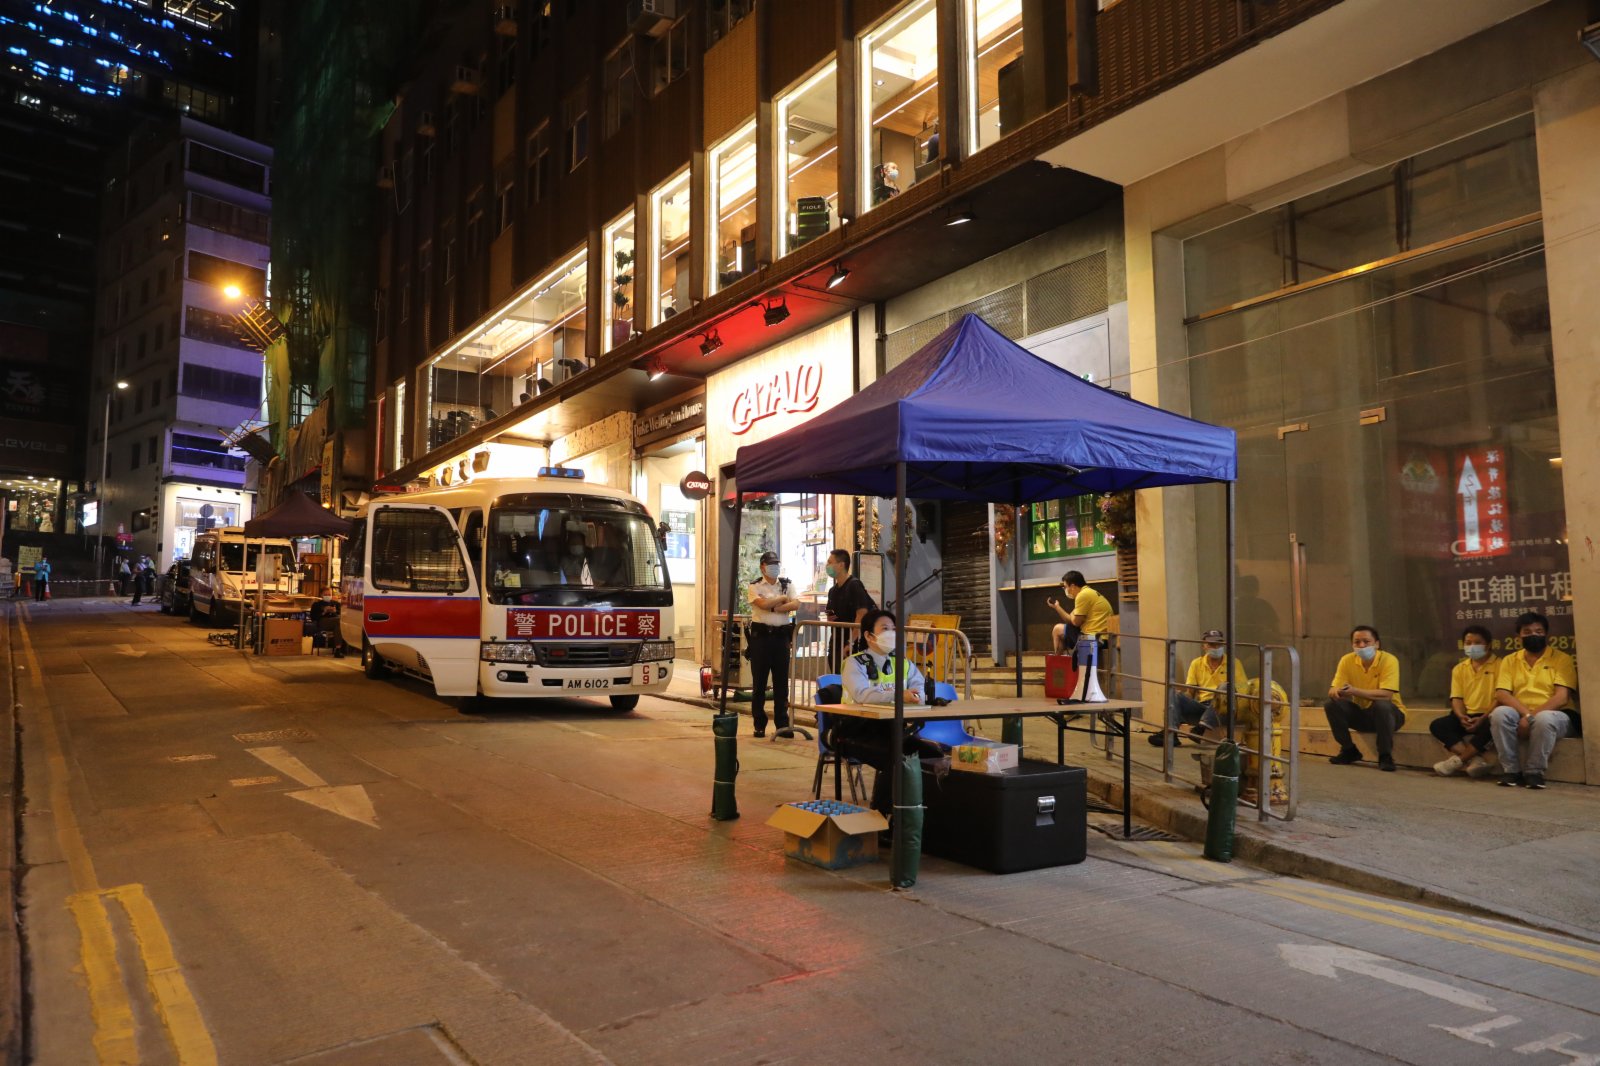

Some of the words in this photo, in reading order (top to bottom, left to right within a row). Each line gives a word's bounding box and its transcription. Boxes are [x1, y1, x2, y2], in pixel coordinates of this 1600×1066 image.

[686, 481, 709, 490] CATALO
[514, 612, 536, 636] 警
[548, 614, 628, 637] POLICE
[637, 613, 655, 636] 察
[642, 665, 650, 675] C
[567, 680, 582, 689] AM
[584, 679, 609, 689] 6102
[642, 675, 650, 685] 9
